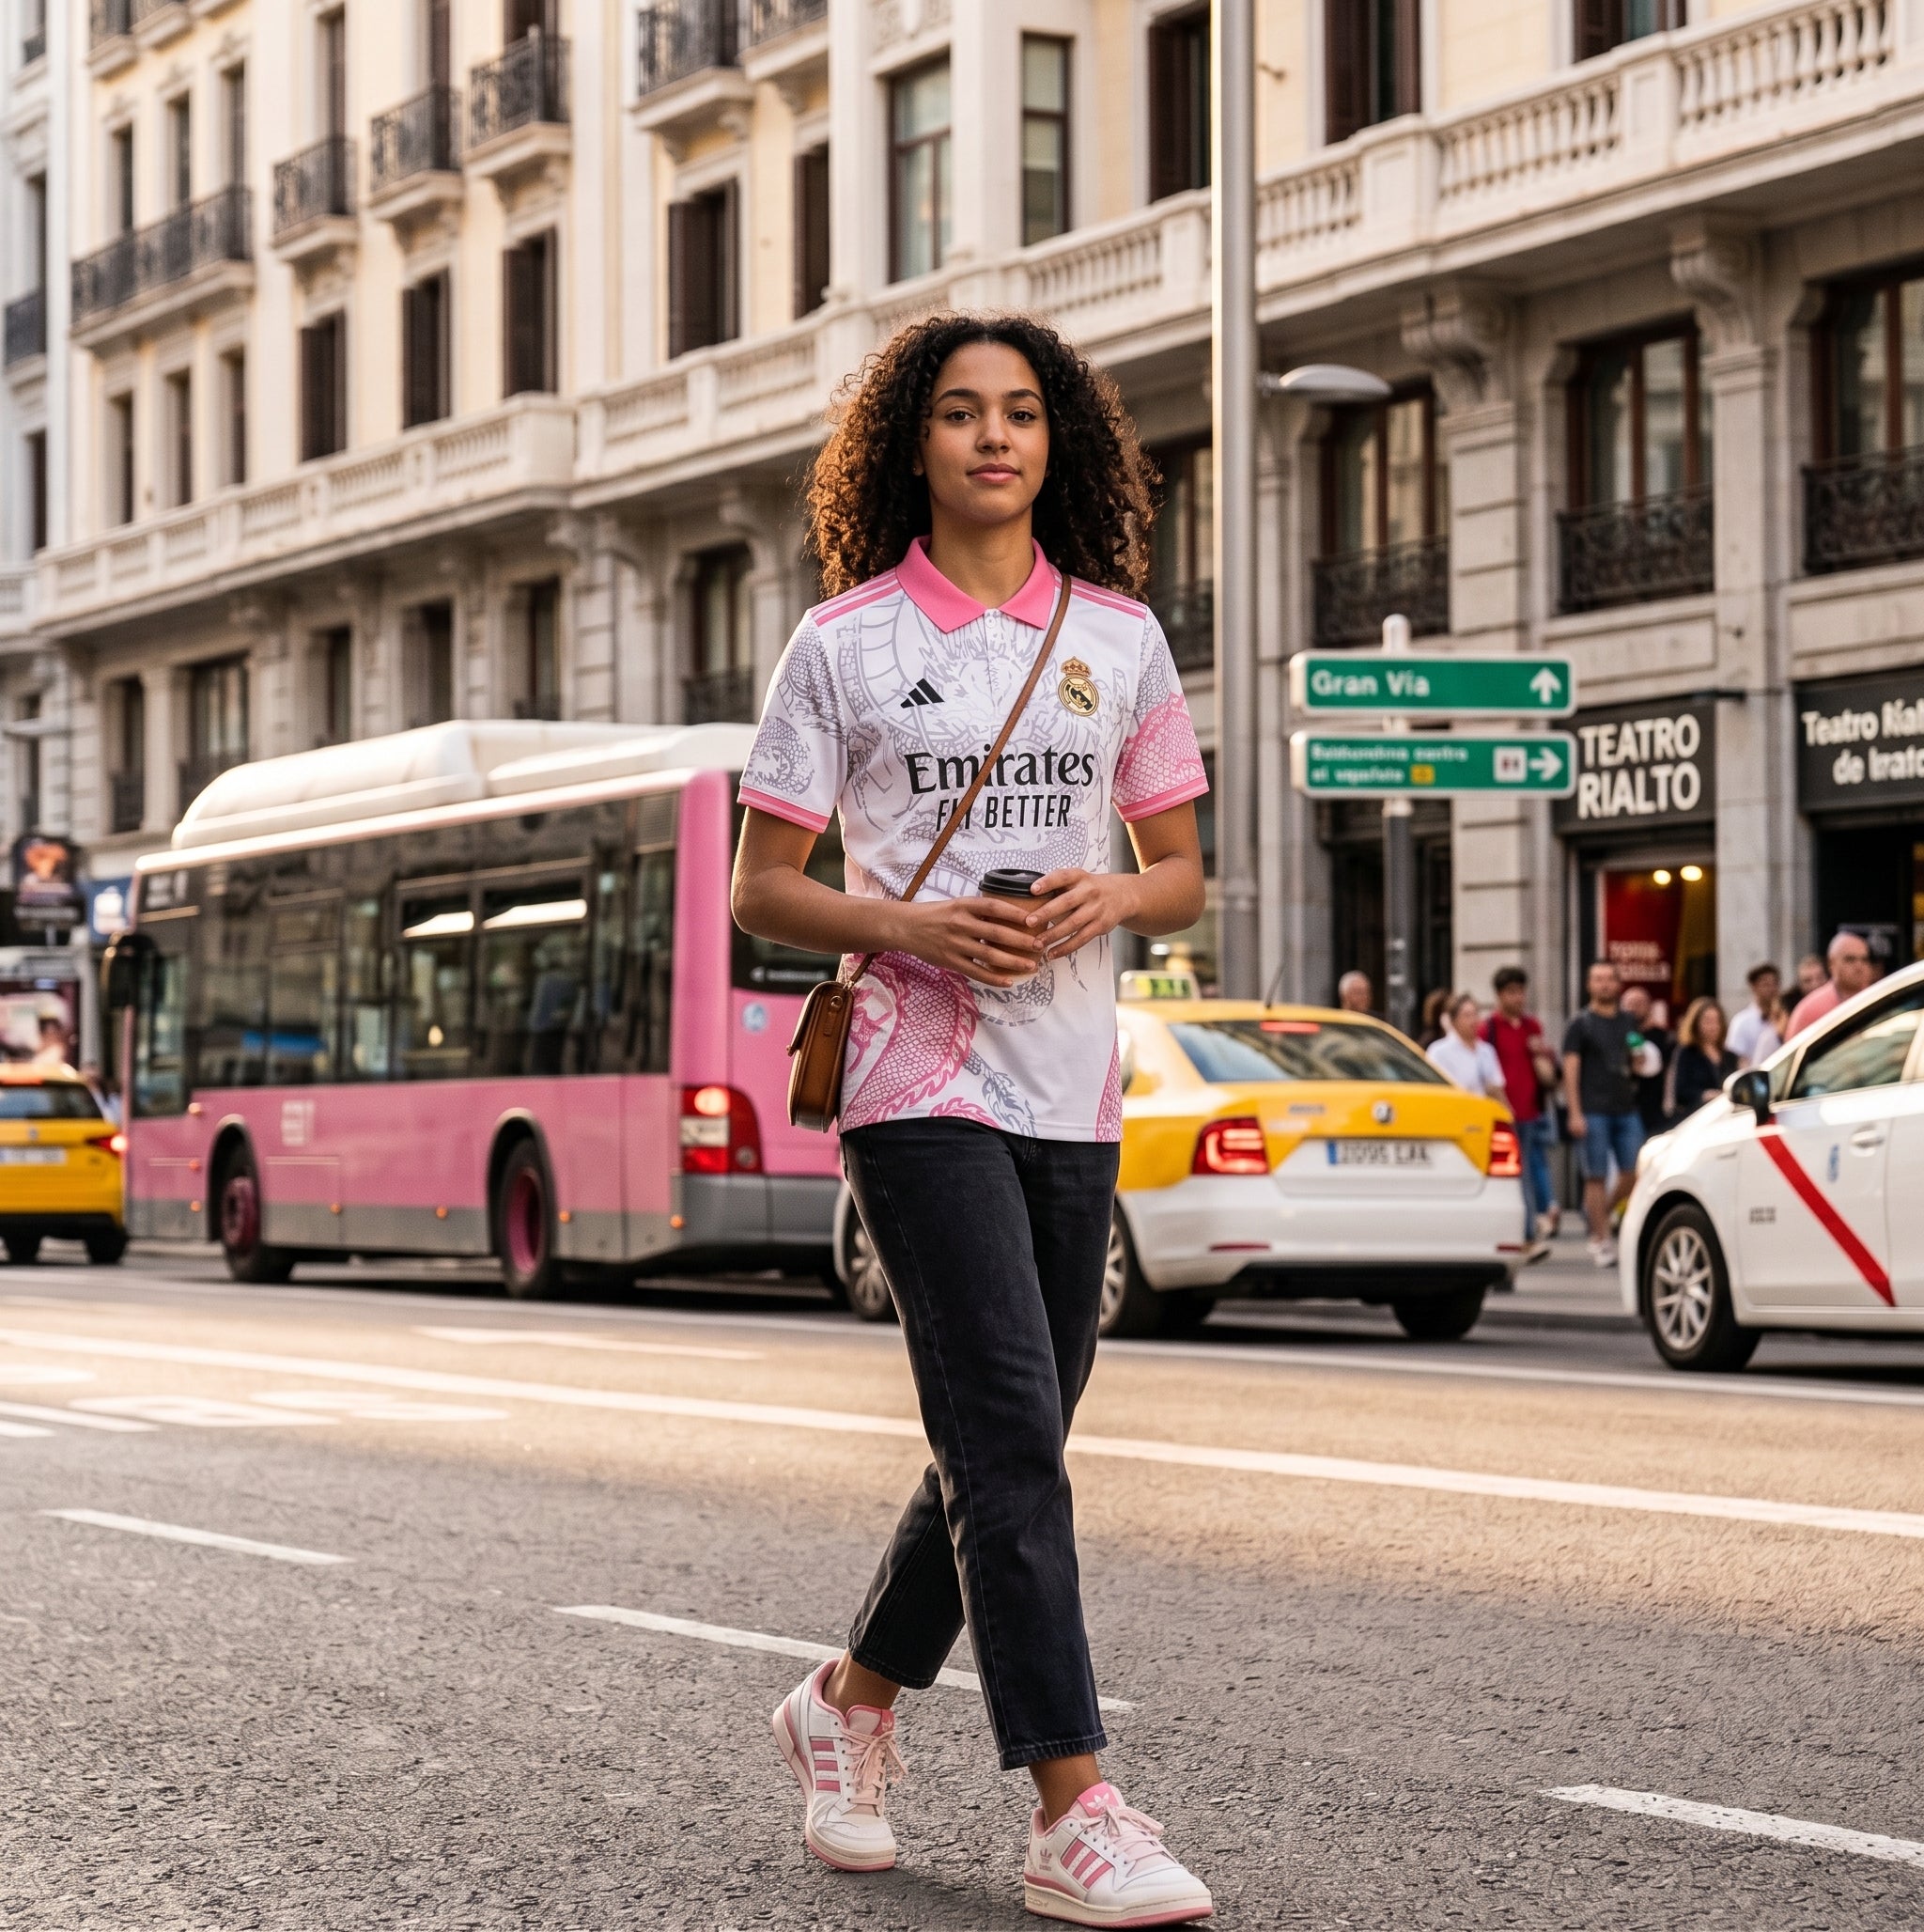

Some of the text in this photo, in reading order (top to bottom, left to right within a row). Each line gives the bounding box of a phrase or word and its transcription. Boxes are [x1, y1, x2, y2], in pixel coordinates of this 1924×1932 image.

[1311, 669, 1377, 695] Gran
[1578, 714, 1700, 768] TEATRO
[1802, 709, 1879, 746] Teatro
[1833, 749, 1865, 784] de
[1578, 762, 1700, 818] RIALTO
[985, 795, 1071, 828] BETTER
